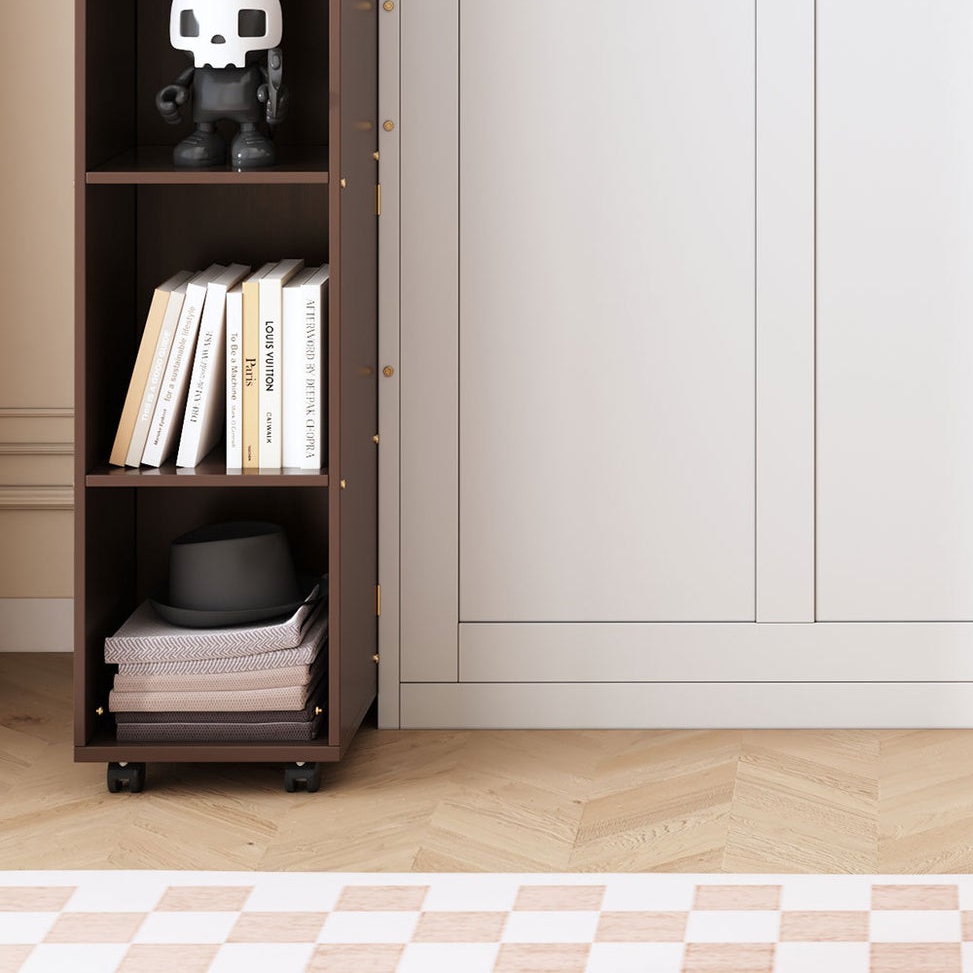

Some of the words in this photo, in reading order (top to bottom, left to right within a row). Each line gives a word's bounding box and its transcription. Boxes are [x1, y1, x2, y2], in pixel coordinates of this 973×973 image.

[231, 333, 238, 342] To
[265, 321, 274, 349] LOUIS
[306, 300, 315, 360] AFTERWORD
[164, 390, 173, 401] for
[171, 338, 187, 381] sustainable
[182, 306, 195, 336] lifestyle
[231, 344, 238, 355] Be
[190, 390, 202, 422] DREAM
[201, 331, 213, 360] AWAKE
[245, 358, 256, 386] Paris
[265, 352, 274, 391] VUITTON
[306, 364, 315, 376] BY
[306, 379, 315, 415] DEEPAK
[306, 419, 315, 458] CHOPRA
